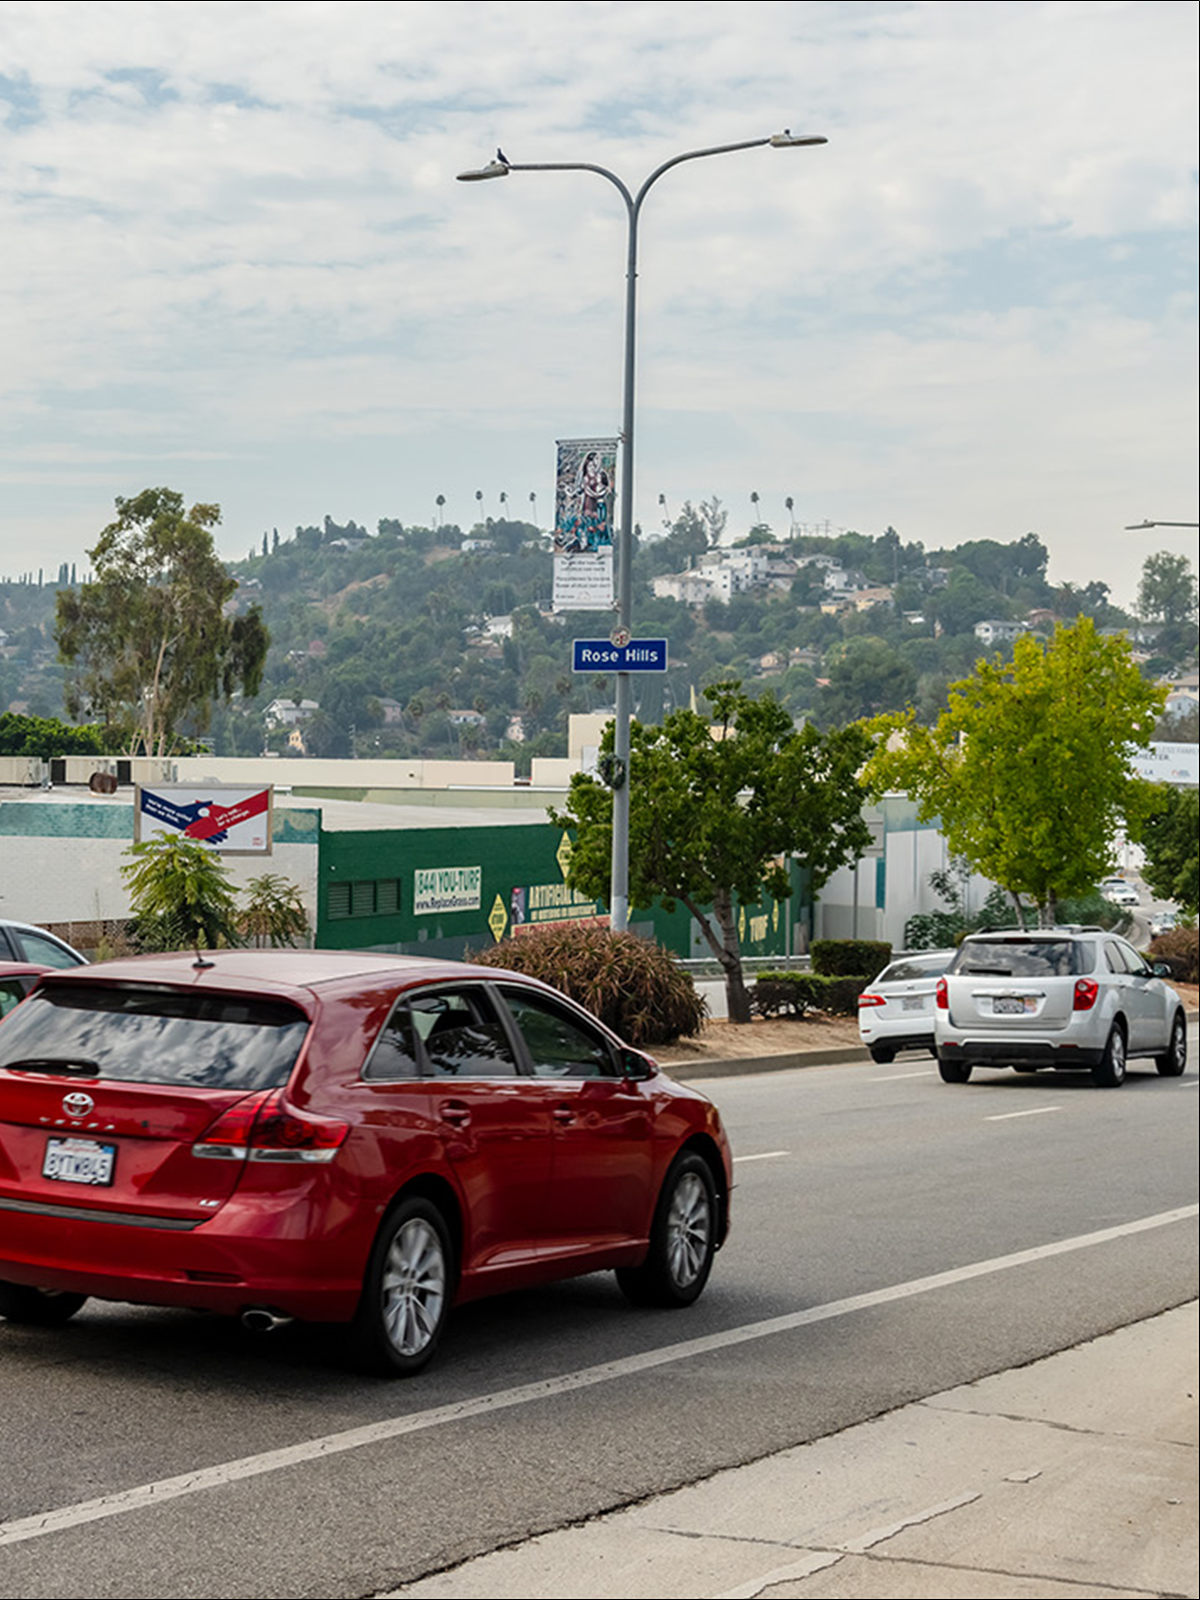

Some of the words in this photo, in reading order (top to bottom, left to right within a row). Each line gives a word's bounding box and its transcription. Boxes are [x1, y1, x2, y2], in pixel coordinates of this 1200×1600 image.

[581, 649, 619, 662] Rose
[625, 648, 659, 662] Hills
[438, 869, 480, 893] YOU-TURF
